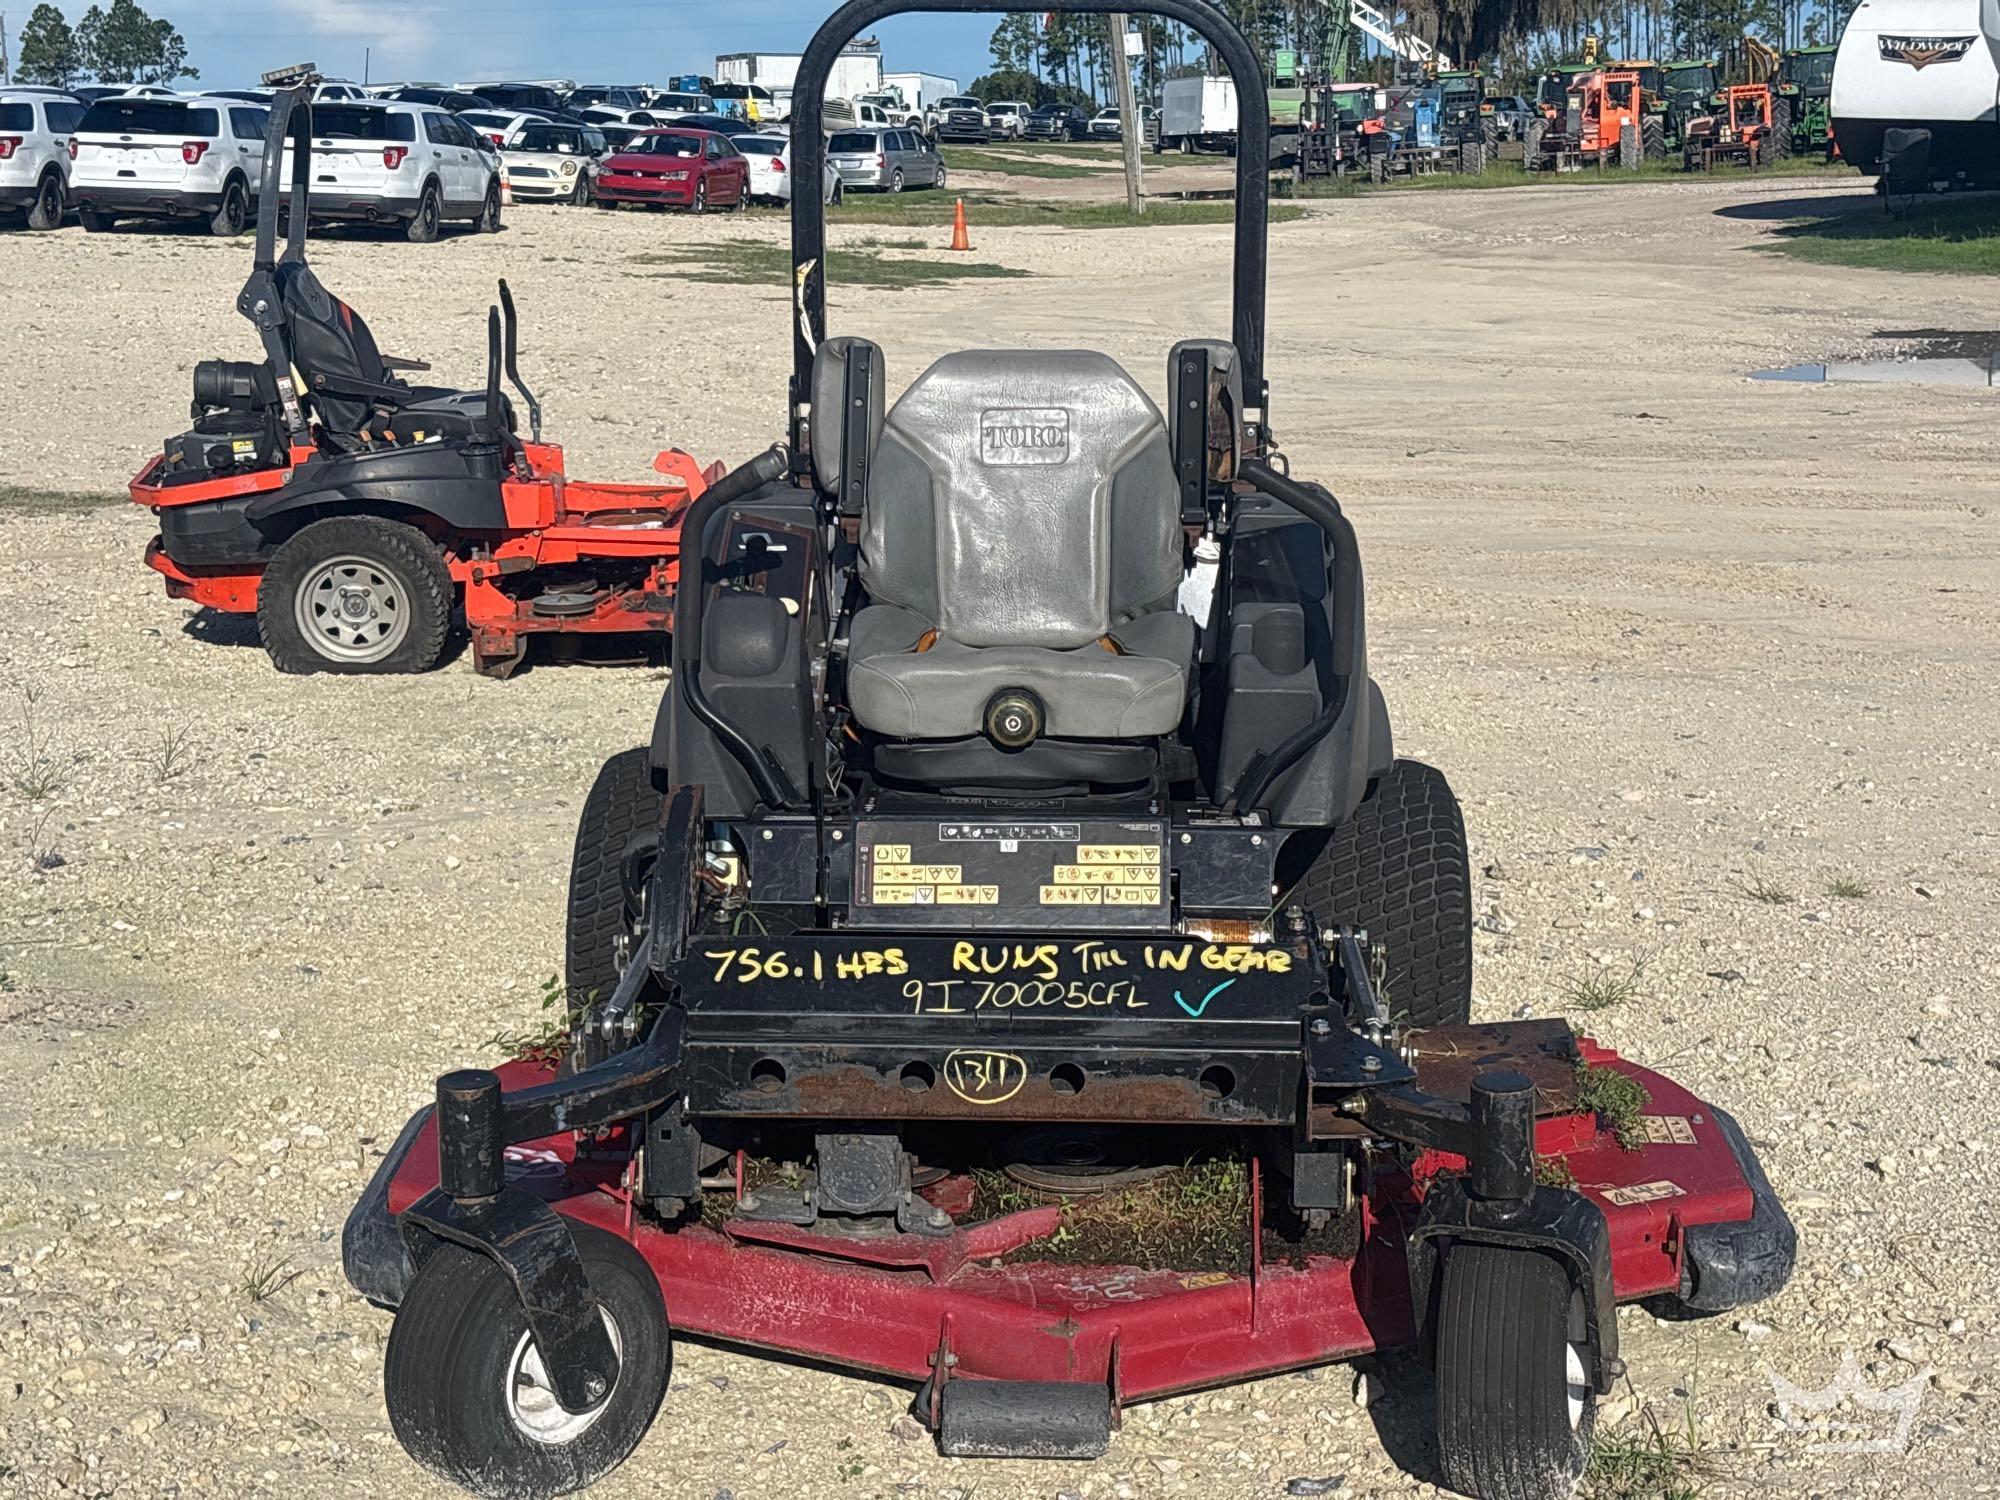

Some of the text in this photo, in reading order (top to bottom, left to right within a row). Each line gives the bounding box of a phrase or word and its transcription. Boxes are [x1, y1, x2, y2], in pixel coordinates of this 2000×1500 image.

[1880, 40, 1970, 51] WILDWOOD
[986, 426, 1063, 448] TORO
[704, 948, 823, 982] 756.1
[837, 948, 909, 979] HRS
[953, 941, 1059, 978] RUNS
[1144, 944, 1193, 971] IN
[1200, 945, 1292, 974] GEAR
[954, 1056, 1006, 1091] 1311
